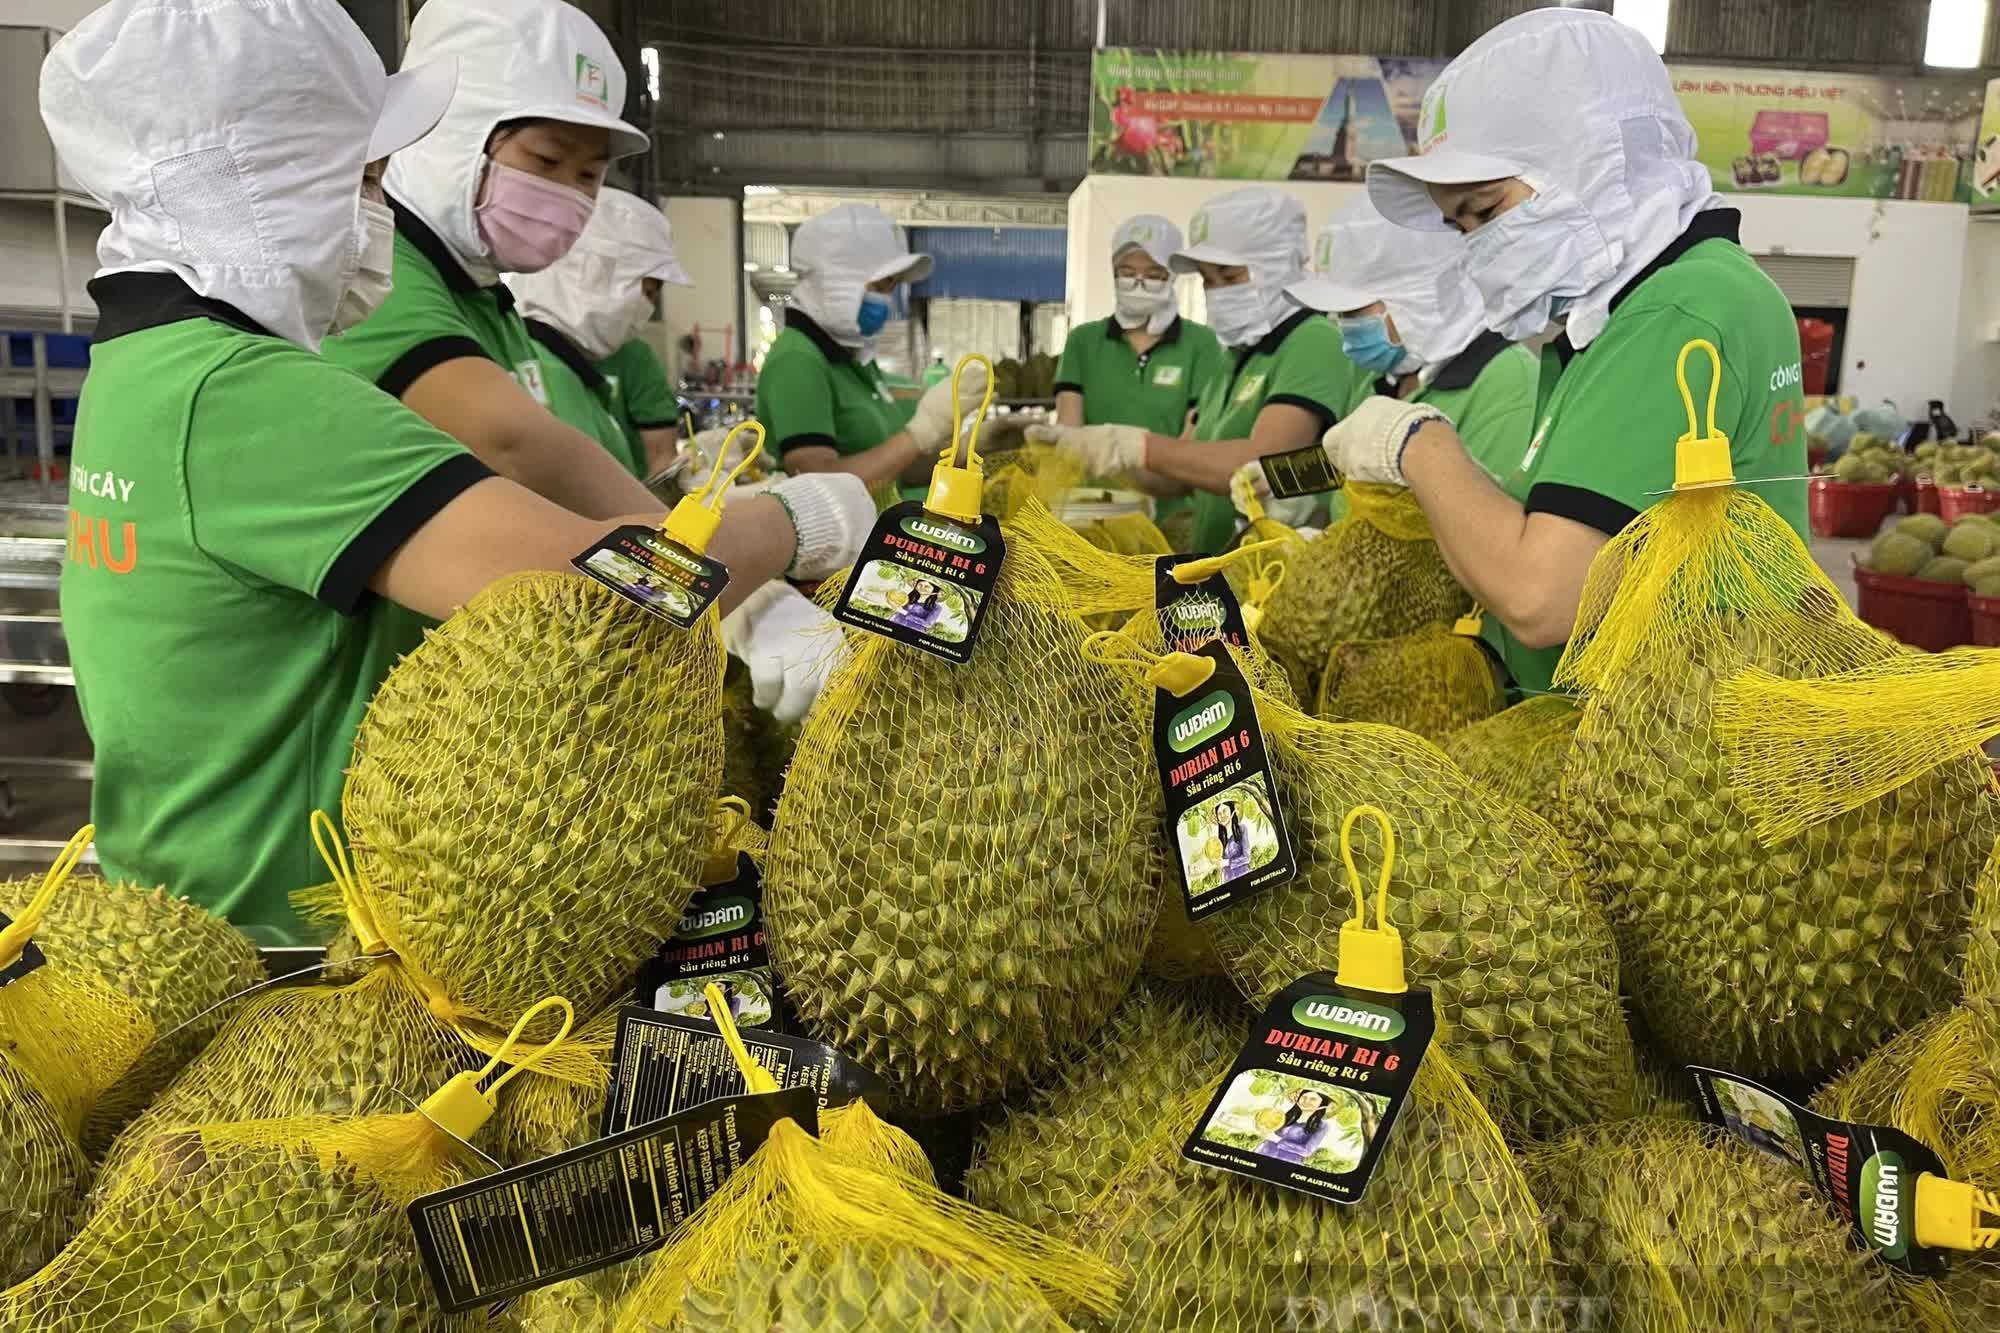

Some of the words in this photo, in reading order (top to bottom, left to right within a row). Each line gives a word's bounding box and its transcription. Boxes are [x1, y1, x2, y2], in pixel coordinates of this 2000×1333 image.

[89, 471, 135, 503] CÂY
[620, 538, 677, 574] DURIAN
[883, 533, 947, 562] DURIAN
[951, 552, 972, 570] RI
[975, 563, 986, 575] 6
[916, 558, 943, 574] riêng
[958, 571, 966, 580] 6
[918, 638, 930, 647] FOR
[931, 643, 962, 658] AUSTRALIA
[1170, 746, 1218, 787] DURIAN
[1220, 736, 1237, 758] RI
[1239, 729, 1250, 748] 6
[1202, 768, 1225, 792] riêng
[1223, 764, 1235, 778] Ri
[1235, 759, 1242, 772] 6
[731, 935, 749, 951] RI
[679, 960, 698, 973] Sầu
[701, 958, 727, 971] riêng
[729, 955, 741, 965] Ri
[743, 953, 750, 963] 6
[1265, 1028, 1349, 1060] DURIAN
[1353, 1047, 1379, 1067] RI
[1384, 1055, 1400, 1072] 6
[820, 1056, 834, 1095] Frozen
[1277, 1051, 1302, 1066] Sầu
[1304, 1058, 1338, 1079] riêng
[1341, 1065, 1359, 1079] Ri
[1360, 1070, 1369, 1082] 6
[723, 1104, 739, 1141] Frozen
[696, 1128, 708, 1151] KEEP
[624, 1143, 640, 1180] Calories
[662, 1141, 681, 1191] Nutrition
[699, 1150, 712, 1183] FROZEN
[728, 1141, 742, 1170] Duria
[1192, 1146, 1220, 1160] Produce
[1230, 1156, 1257, 1169] Vietnam
[1290, 1172, 1306, 1181] FOR
[1306, 1176, 1349, 1194] AUSTRALIA
[670, 1192, 685, 1223] Facts
[639, 1224, 653, 1242] 360
